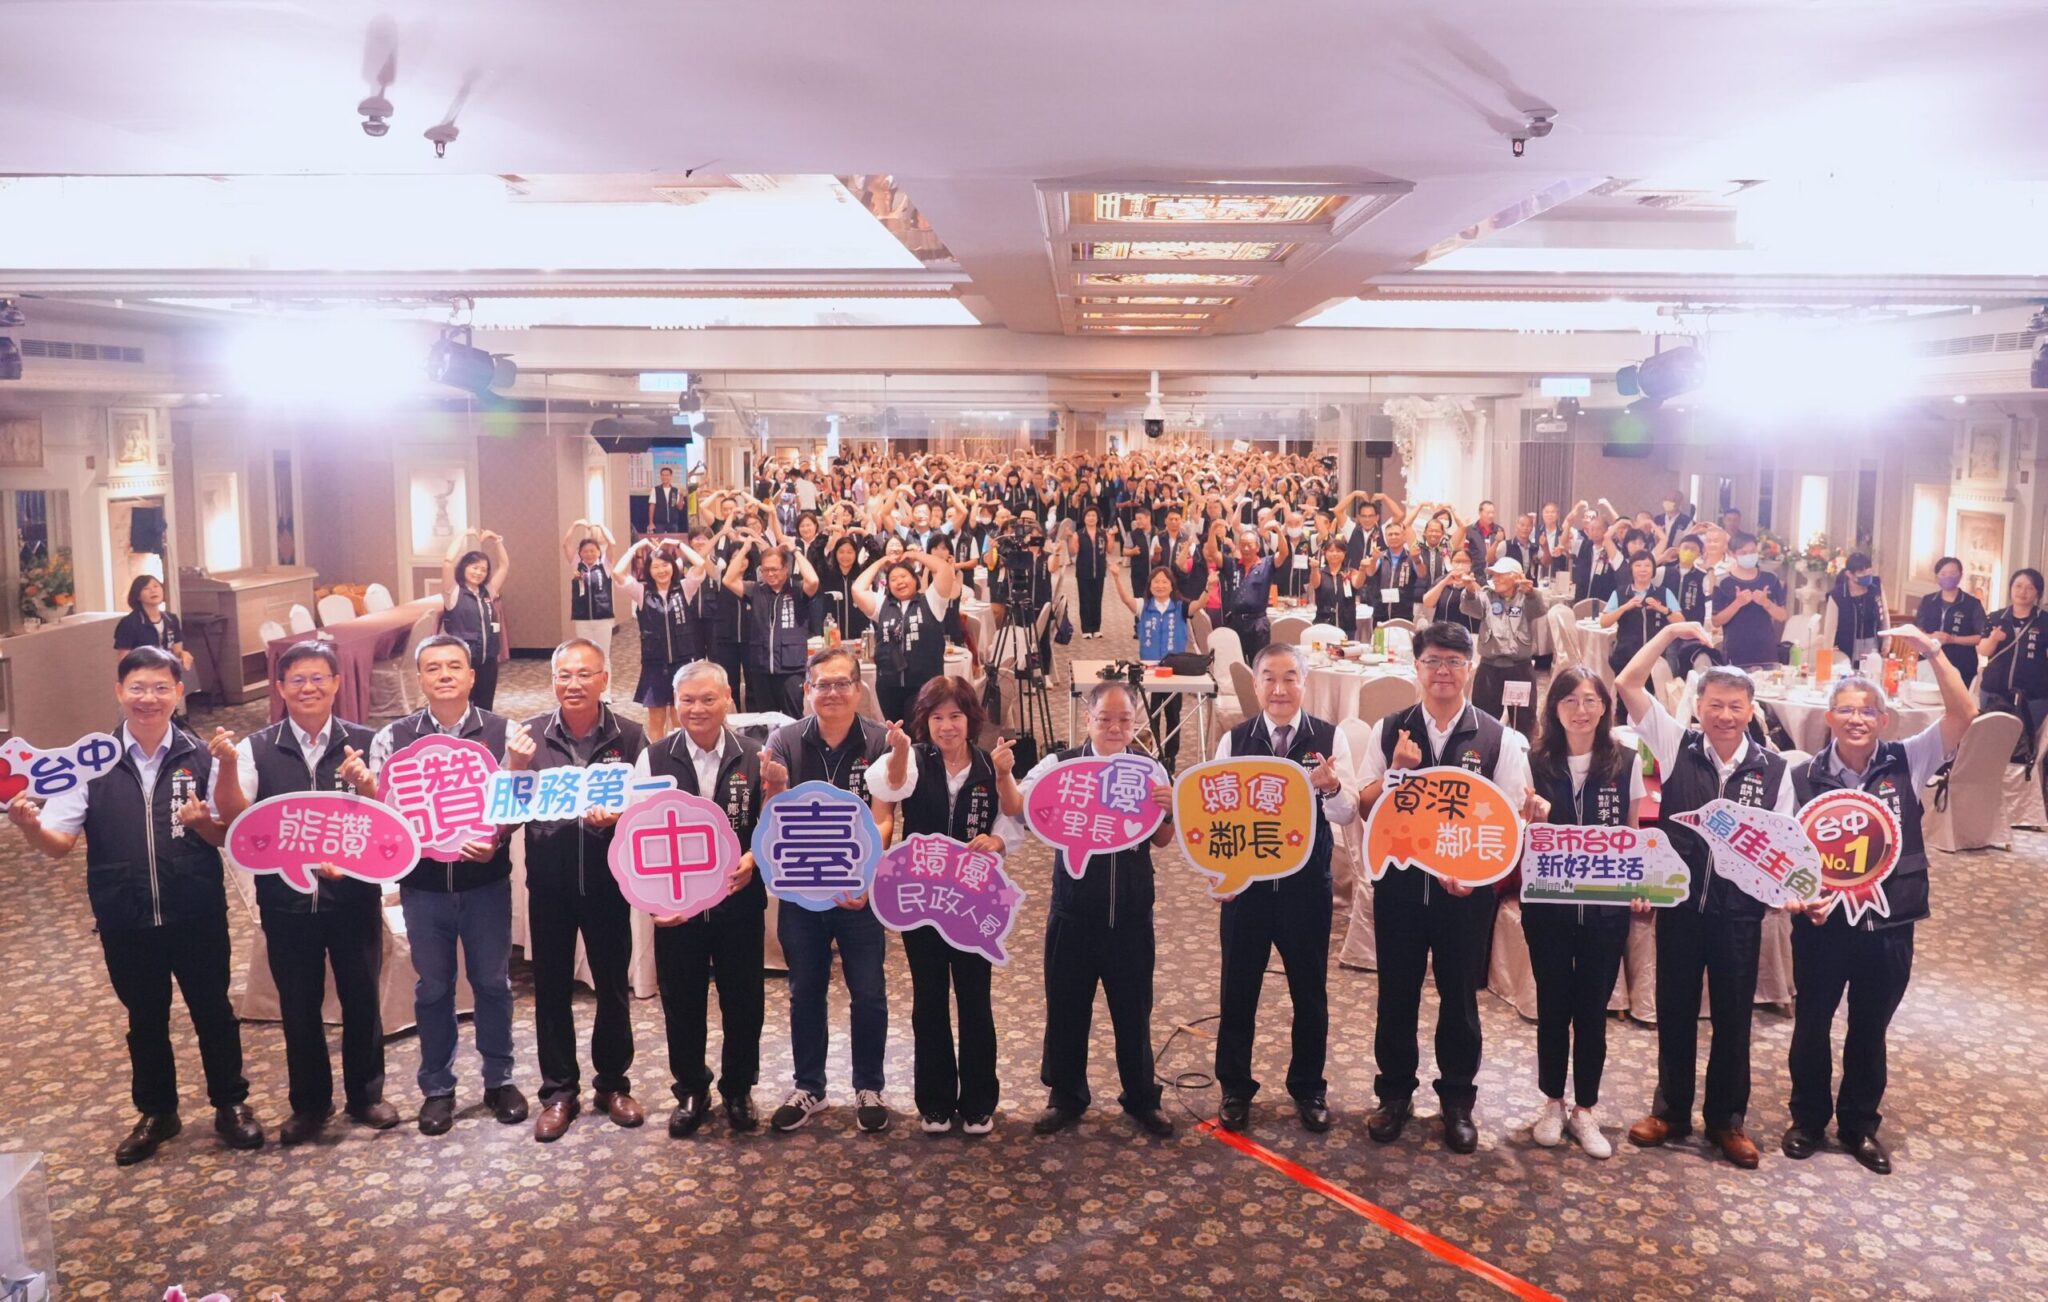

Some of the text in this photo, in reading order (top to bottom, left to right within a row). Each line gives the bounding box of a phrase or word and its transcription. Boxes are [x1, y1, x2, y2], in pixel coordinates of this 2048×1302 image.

[30, 738, 116, 795] 台中
[1057, 761, 1151, 814] 特優
[391, 750, 495, 845] 讚
[489, 767, 672, 819] 服務第一
[1200, 772, 1287, 814] 績優
[1387, 774, 1471, 820] 資深
[277, 805, 373, 860] 熊讚
[772, 800, 863, 888] 臺
[1062, 810, 1117, 845] 里長
[1209, 820, 1284, 859] 鄰長
[1434, 821, 1507, 862] 鄰長
[1529, 826, 1637, 855] 富市台中
[1814, 810, 1870, 843] 台中
[631, 809, 718, 901] 中
[910, 839, 996, 892] 績優
[1537, 853, 1645, 881] 新好生活
[1705, 808, 1818, 901] 最佳主角
[1820, 834, 1870, 875] No.1
[896, 882, 1002, 938] 民政人員
